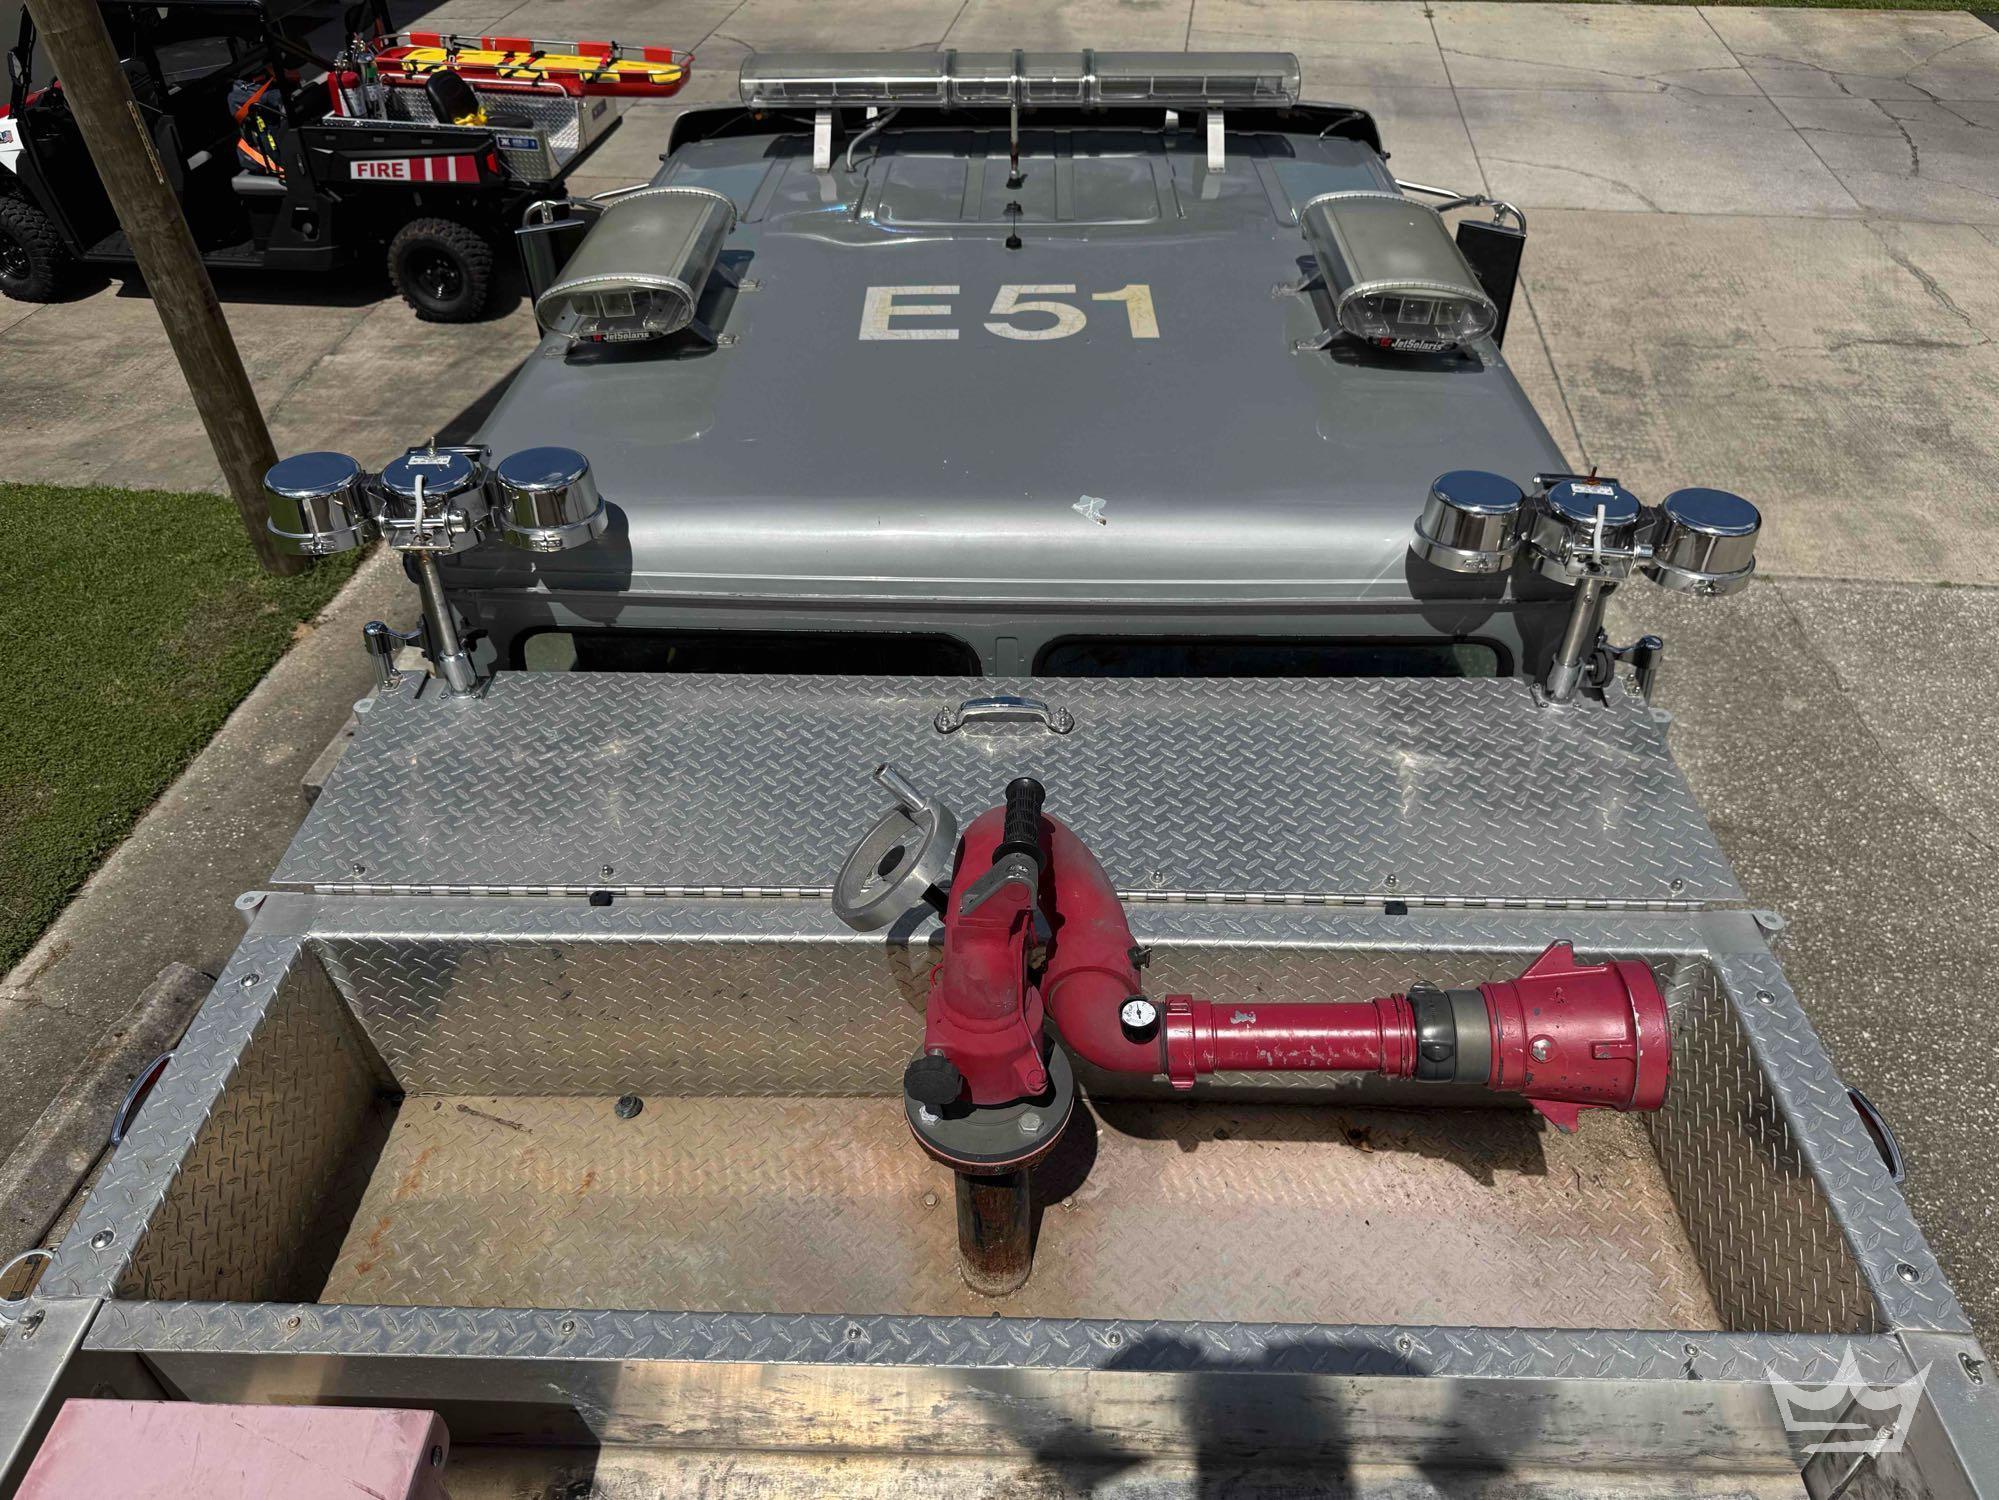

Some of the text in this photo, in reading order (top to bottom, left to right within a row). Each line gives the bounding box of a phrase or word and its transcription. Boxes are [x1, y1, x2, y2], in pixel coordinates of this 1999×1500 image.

[356, 162, 404, 178] FIRE
[858, 284, 1160, 341] E 51
[1391, 338, 1446, 351] JetSolaris
